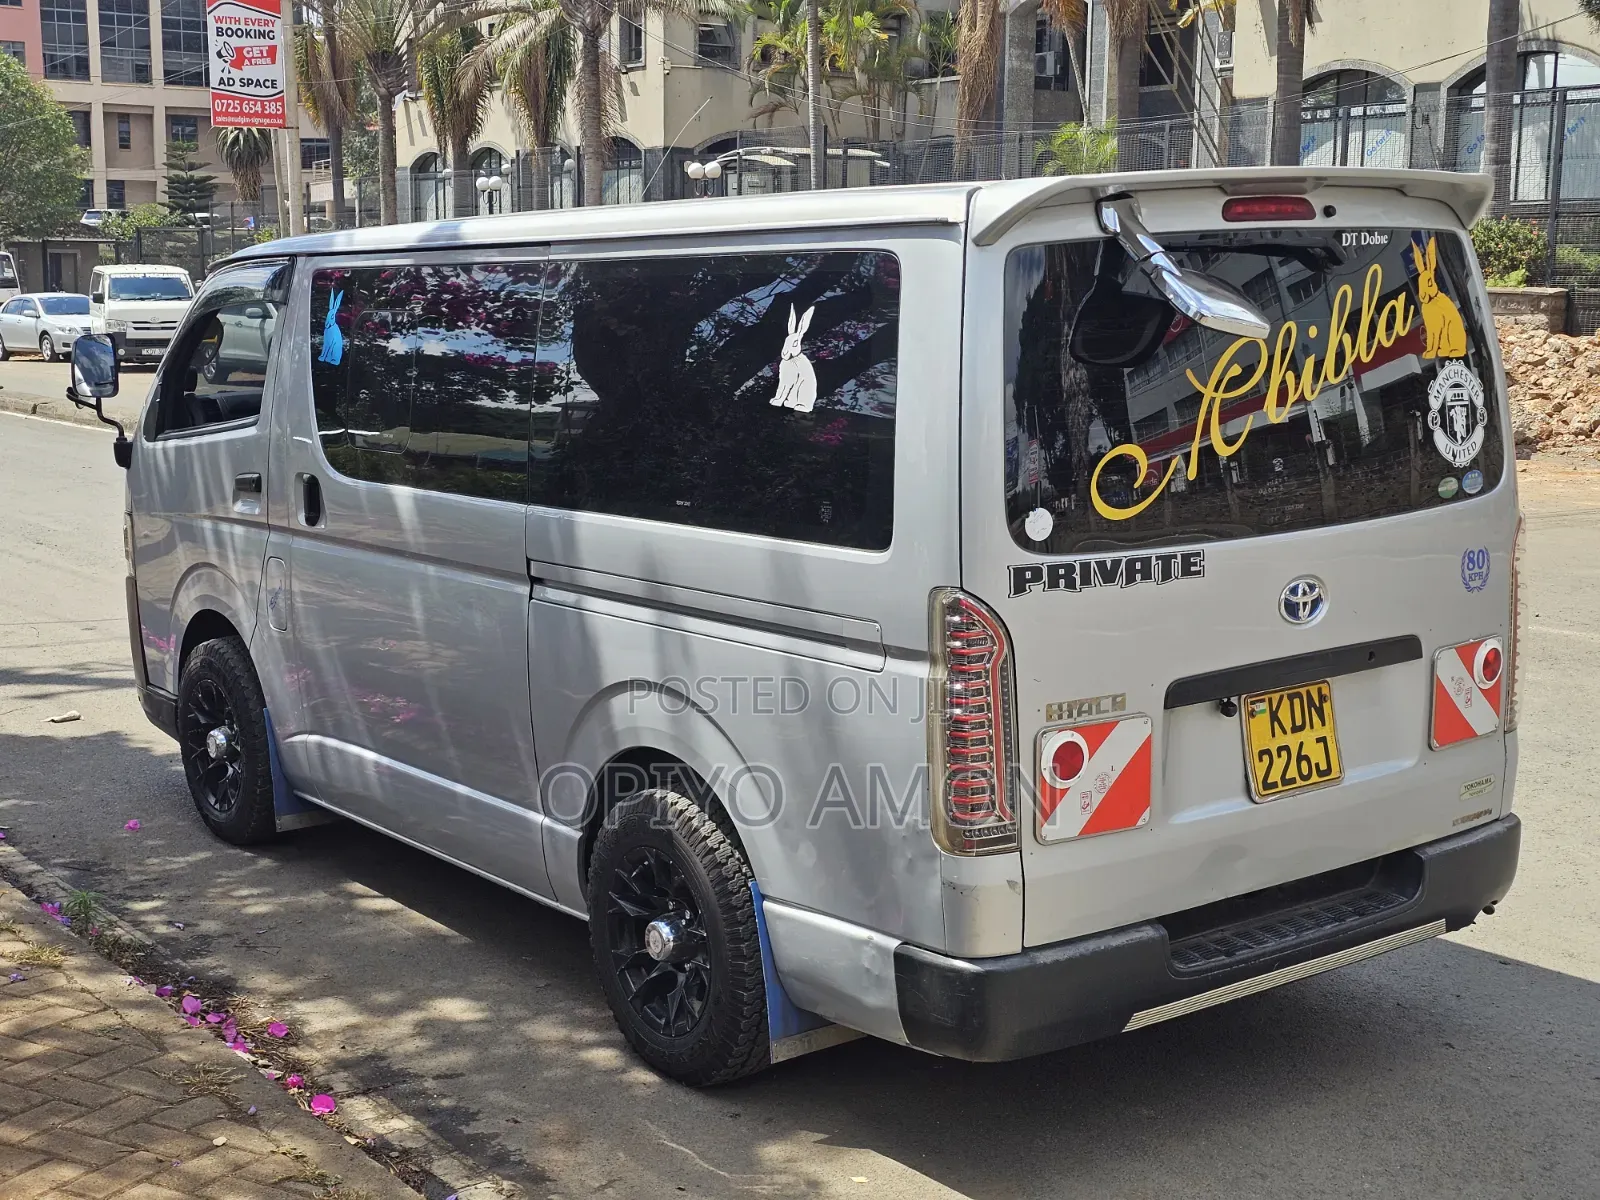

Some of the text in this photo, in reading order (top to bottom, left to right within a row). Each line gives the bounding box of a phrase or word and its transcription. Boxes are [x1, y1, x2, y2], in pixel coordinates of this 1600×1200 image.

[213, 15, 276, 27] WITH EVERY
[216, 27, 275, 40] BOOKING
[243, 46, 269, 58] GET
[218, 77, 278, 89] AD SPACE
[214, 99, 283, 114] 0725 654 385
[1341, 231, 1389, 246] DT Dobie
[1433, 367, 1480, 403] MANCHESTER
[1444, 441, 1478, 461] UNITED
[1467, 549, 1486, 571] 80
[1007, 549, 1205, 599] PRIVATE
[1468, 571, 1484, 582] KPH
[1267, 686, 1327, 738] KDN
[1257, 735, 1333, 791] 226J
[1463, 777, 1492, 791] YOKOHAMA
